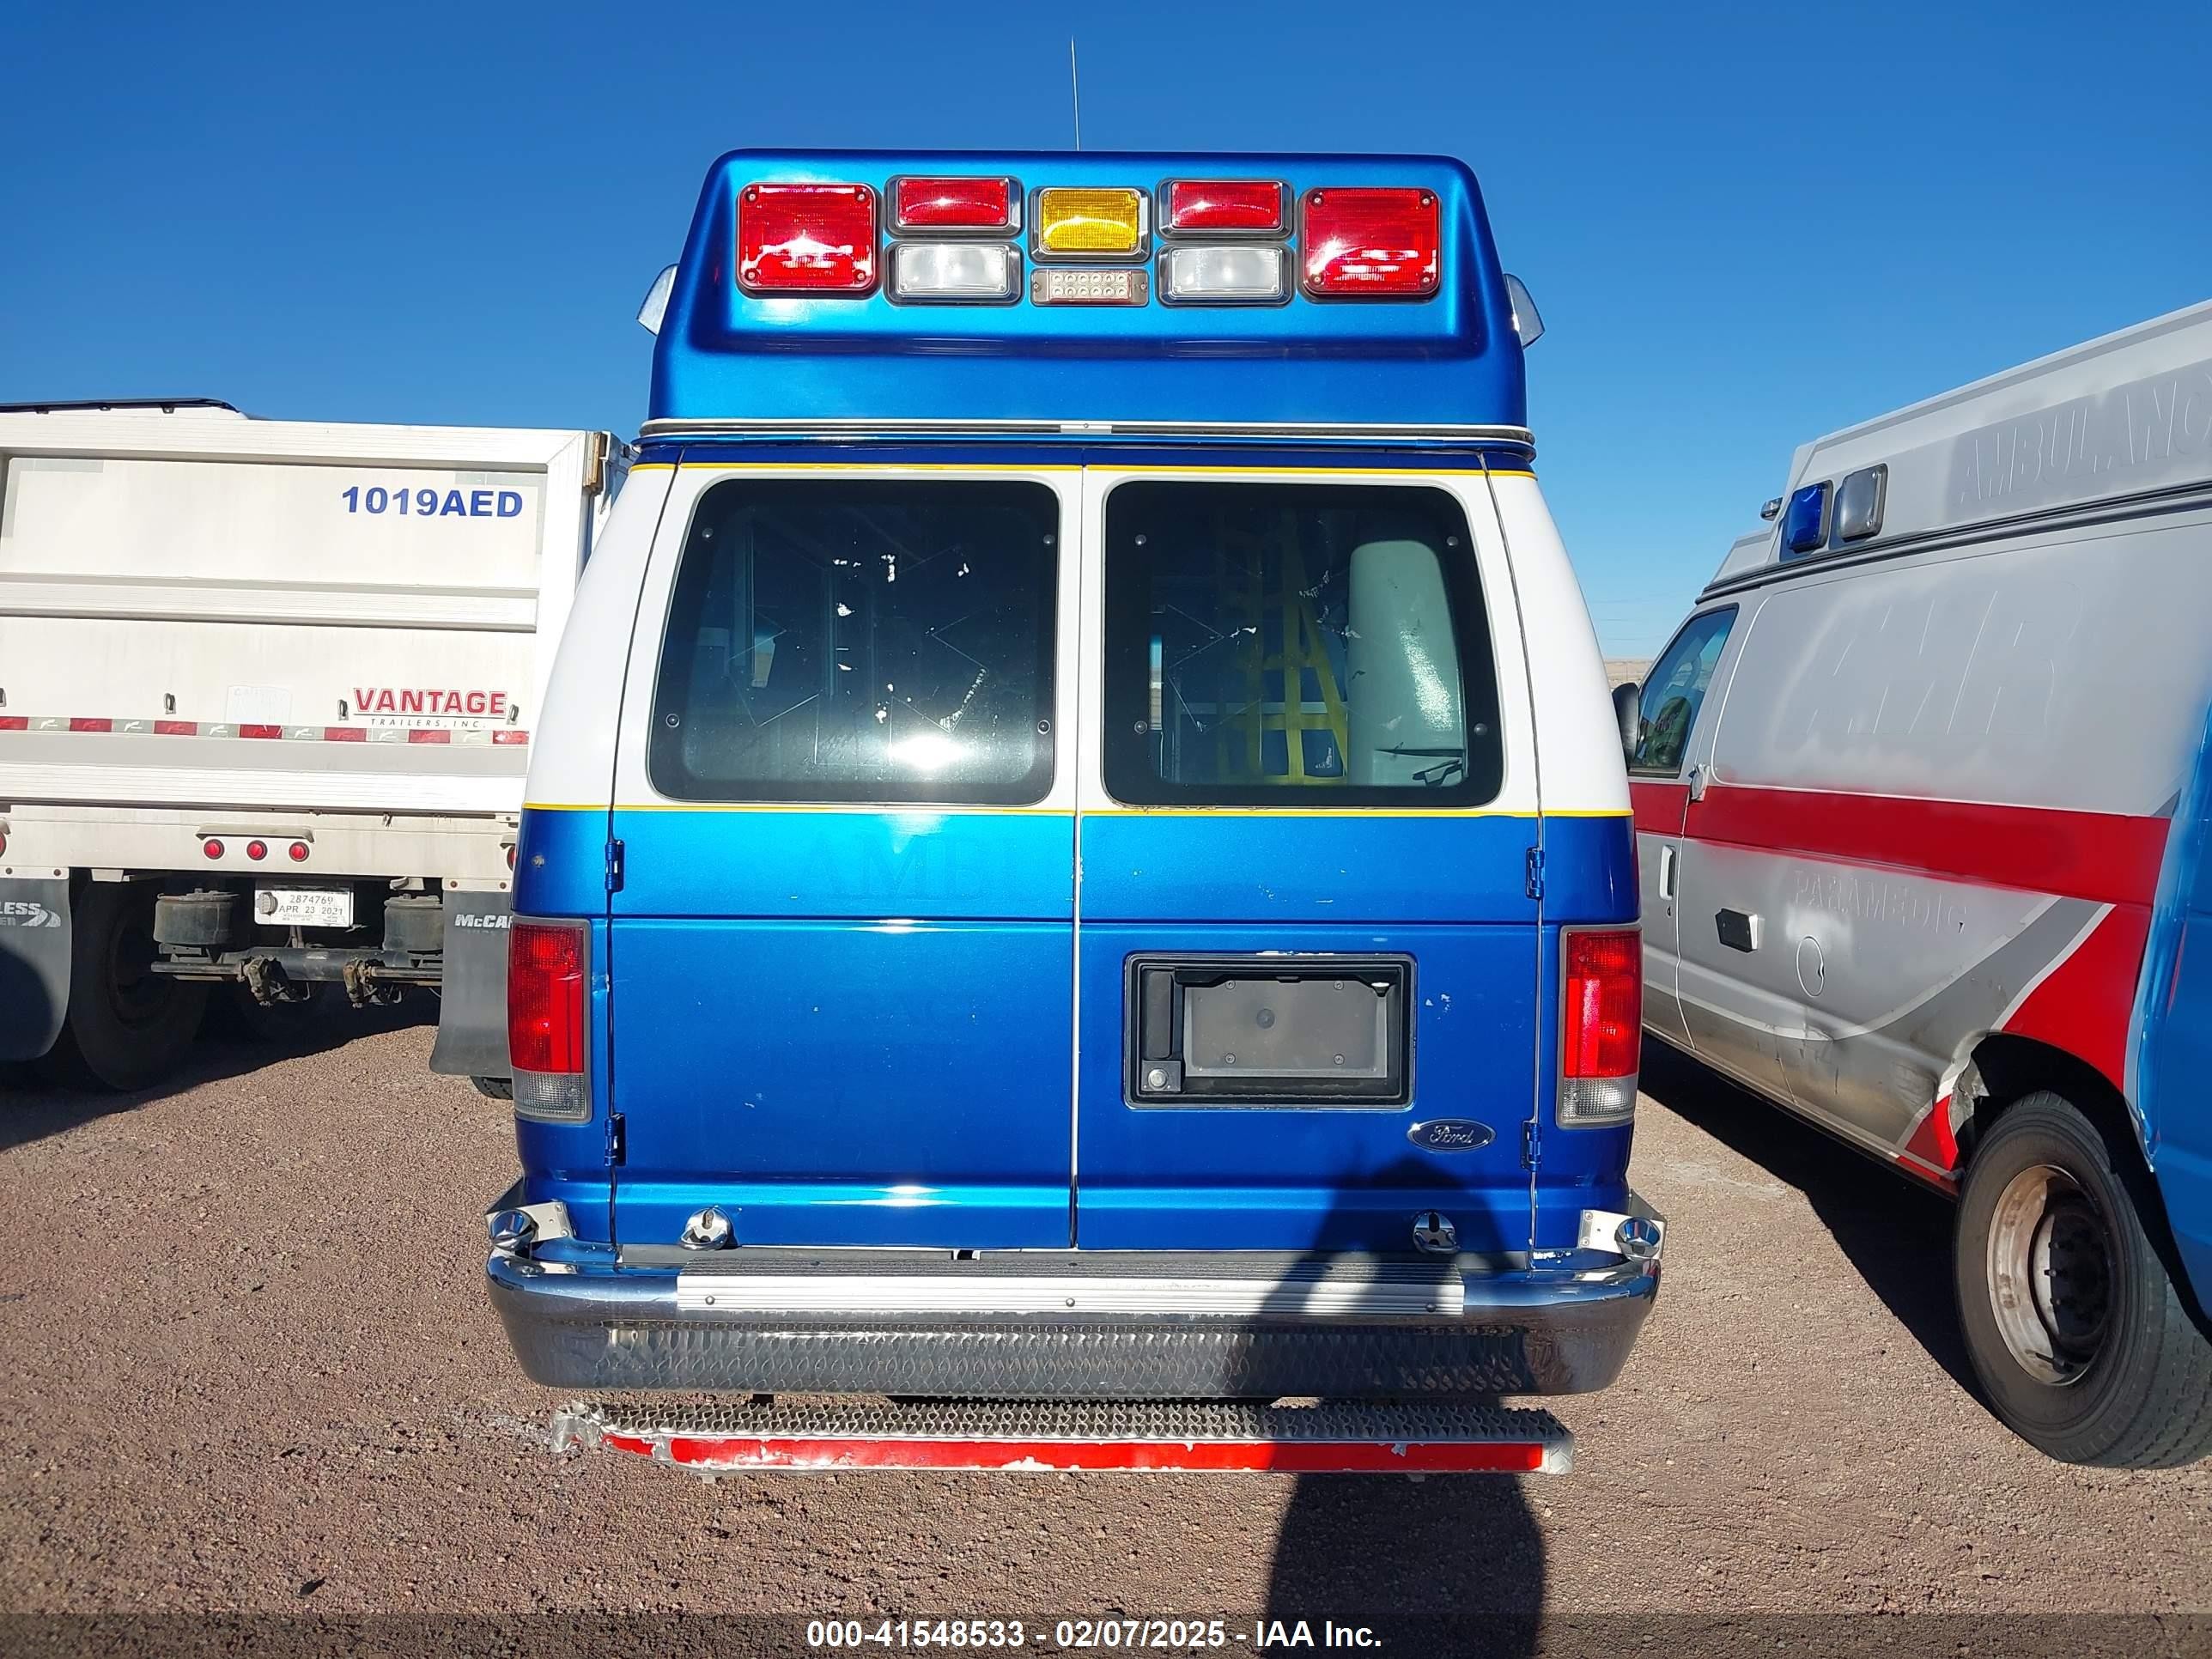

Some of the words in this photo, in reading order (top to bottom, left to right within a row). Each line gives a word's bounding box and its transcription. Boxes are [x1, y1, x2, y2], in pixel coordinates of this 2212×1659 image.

[342, 486, 524, 518] 1019AED
[353, 687, 507, 716] VANTAGE
[1430, 1124, 1474, 1143] Ford
